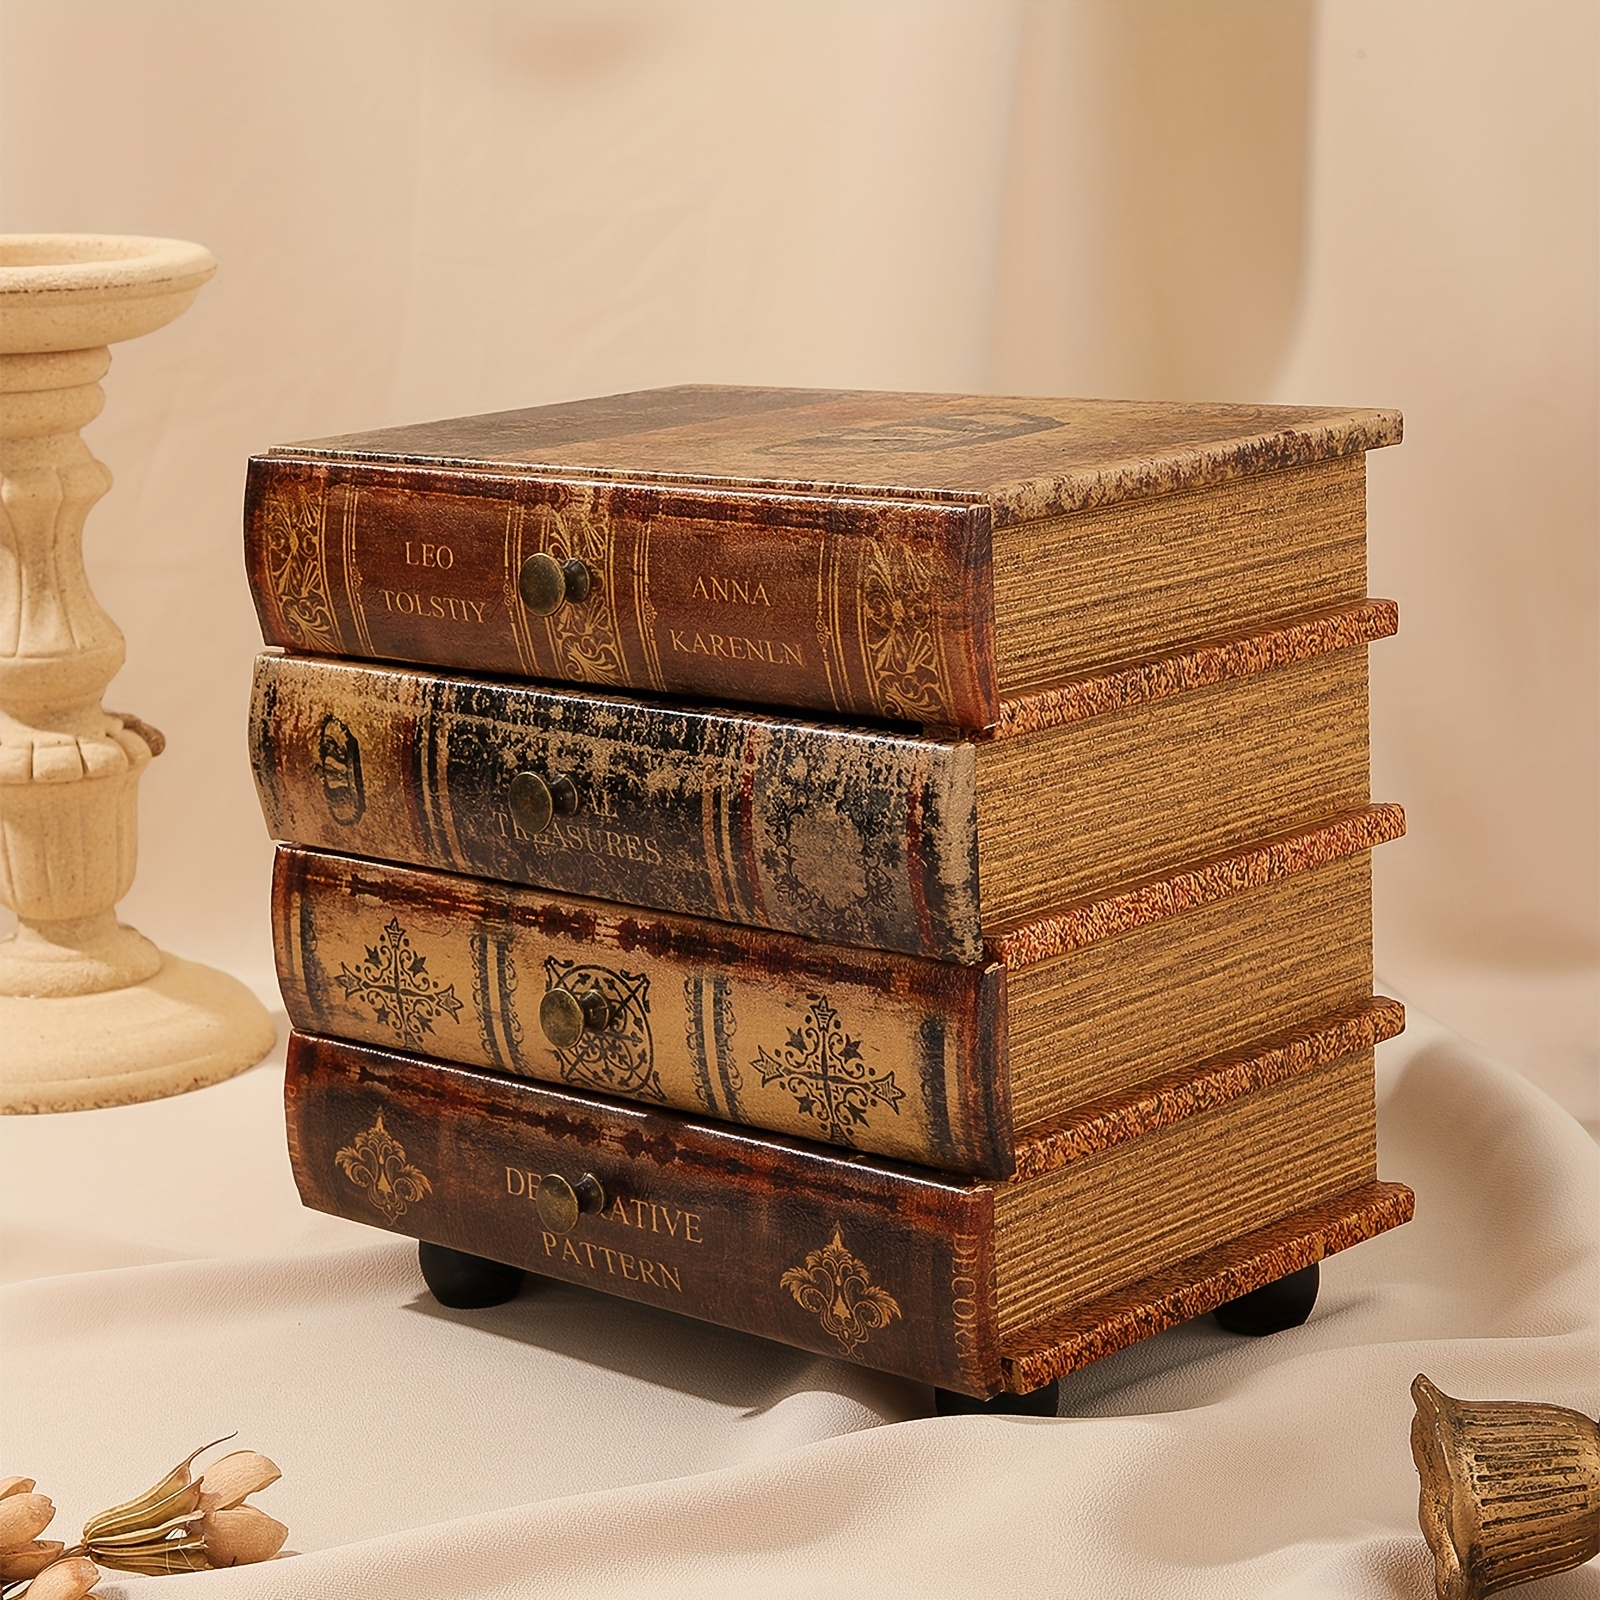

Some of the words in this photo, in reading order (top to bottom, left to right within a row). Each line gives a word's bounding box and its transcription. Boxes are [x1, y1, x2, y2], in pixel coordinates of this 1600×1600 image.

[405, 541, 454, 570] LEO
[379, 589, 486, 624] TOLSTIY
[692, 575, 771, 607] ANNA
[505, 1166, 703, 1244] DEATIVE
[541, 1231, 683, 1293] PATTERN
